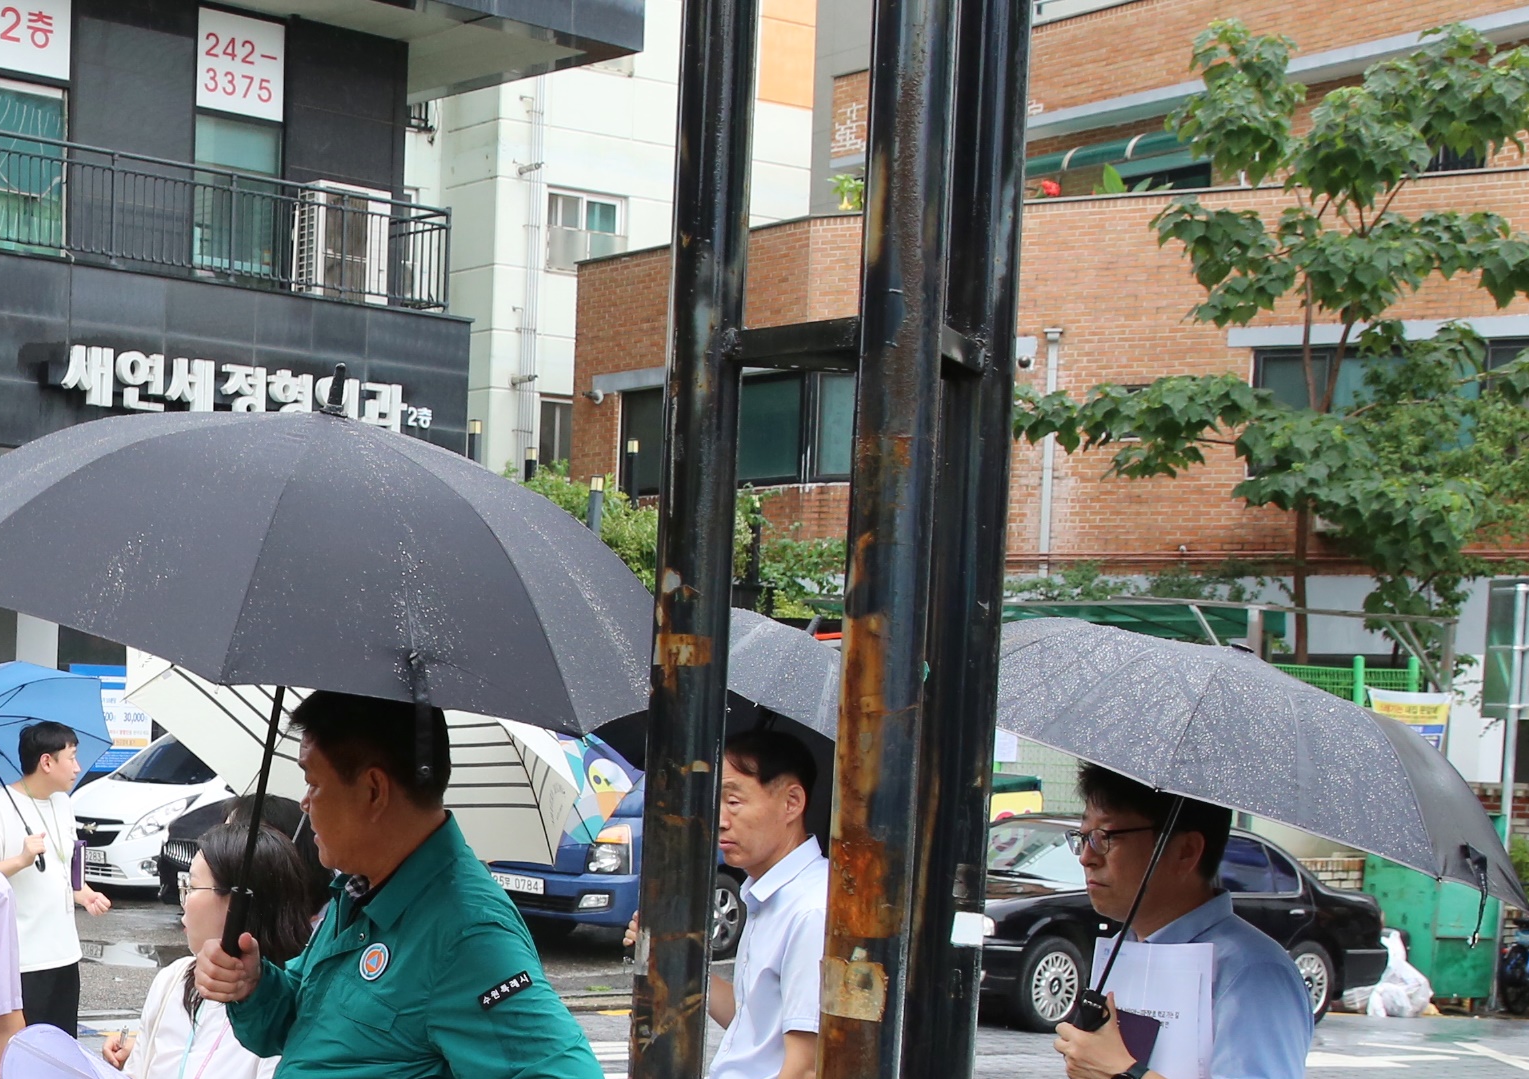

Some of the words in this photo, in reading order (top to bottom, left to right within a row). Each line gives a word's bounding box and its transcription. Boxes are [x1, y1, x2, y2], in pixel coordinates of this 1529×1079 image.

[0, 6, 53, 49] 2층
[205, 32, 278, 65] 242-
[204, 67, 272, 103] 3375
[61, 344, 215, 413] 새연세
[407, 405, 432, 429] 2층
[515, 878, 538, 892] 0784
[483, 973, 529, 1005] 수원특례시
